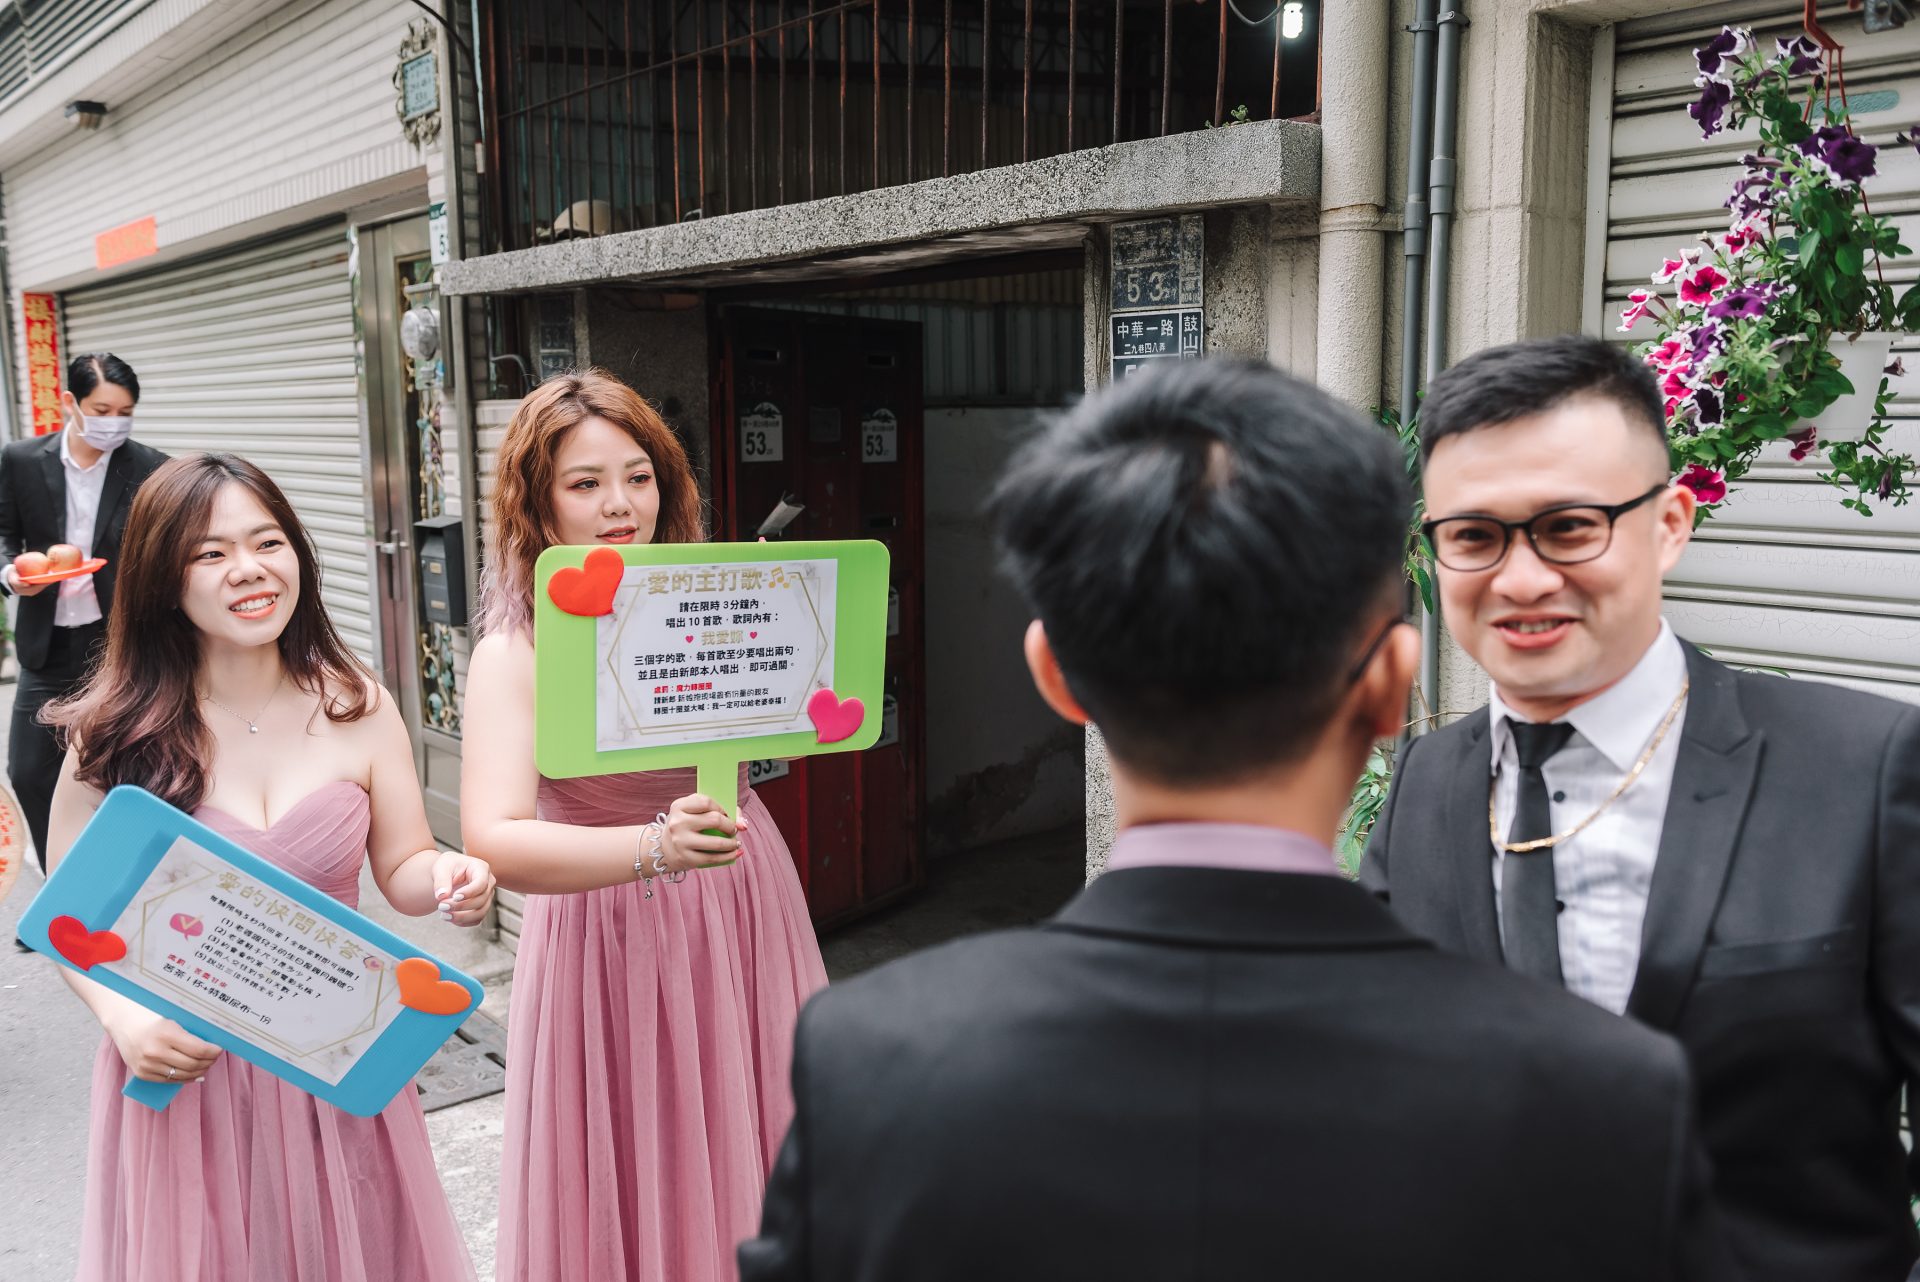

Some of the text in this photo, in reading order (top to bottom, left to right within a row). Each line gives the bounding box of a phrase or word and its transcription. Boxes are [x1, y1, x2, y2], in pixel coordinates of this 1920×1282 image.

[1127, 271, 1166, 303] 53
[1117, 319, 1174, 339] 中華一路
[1124, 342, 1166, 354] 二九巷四八弄
[745, 431, 767, 455] 53
[866, 434, 884, 456] 53
[648, 567, 763, 595] 愛的主打歌
[701, 630, 744, 646] 我愛妳
[215, 870, 364, 959] 愛的快問快答
